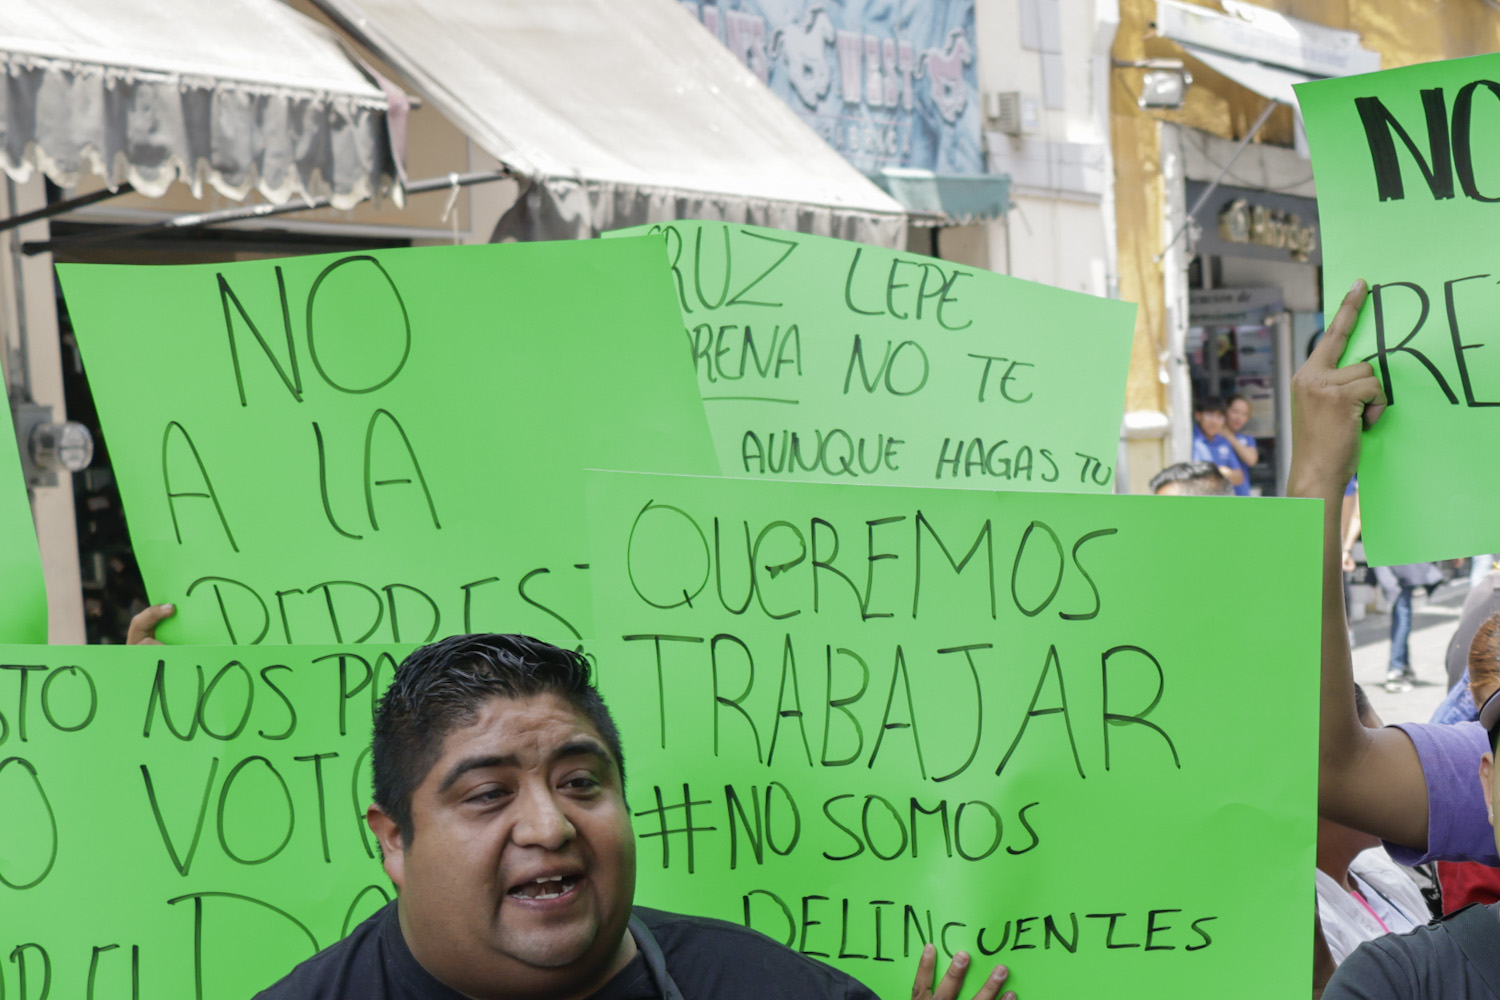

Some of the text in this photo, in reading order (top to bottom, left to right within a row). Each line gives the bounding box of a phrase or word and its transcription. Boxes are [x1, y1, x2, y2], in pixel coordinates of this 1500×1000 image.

[648, 222, 974, 331] RUZ LEPE
[217, 255, 411, 407] NO
[685, 322, 1035, 403] RENA NO TE
[162, 409, 441, 554] A LA
[742, 428, 1112, 486] AUNQUE HAGAS TU
[143, 660, 297, 742] NOS
[623, 633, 1181, 782] TRABAJAR
[823, 794, 1040, 862] SOMOS
